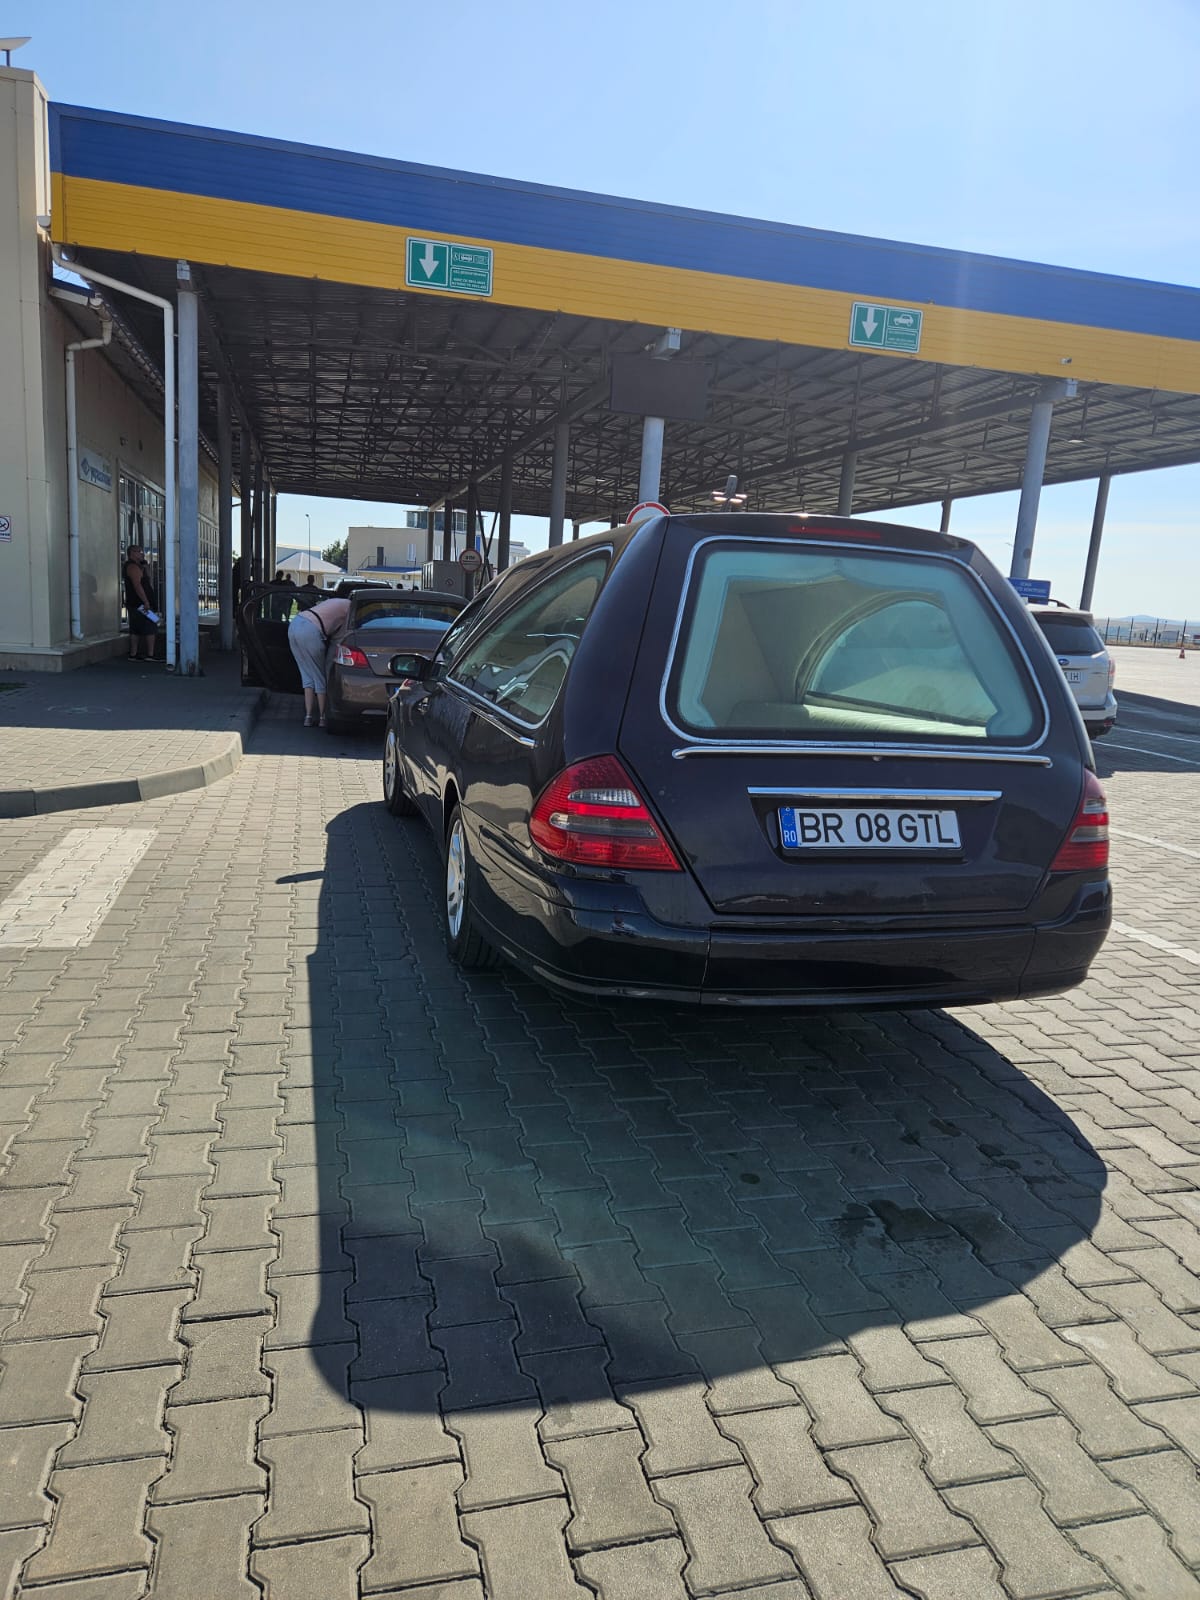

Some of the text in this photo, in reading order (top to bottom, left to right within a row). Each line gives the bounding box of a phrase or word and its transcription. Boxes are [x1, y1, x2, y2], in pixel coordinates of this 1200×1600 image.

[783, 830, 797, 843] RO
[799, 812, 954, 844] BR 08 GTL
